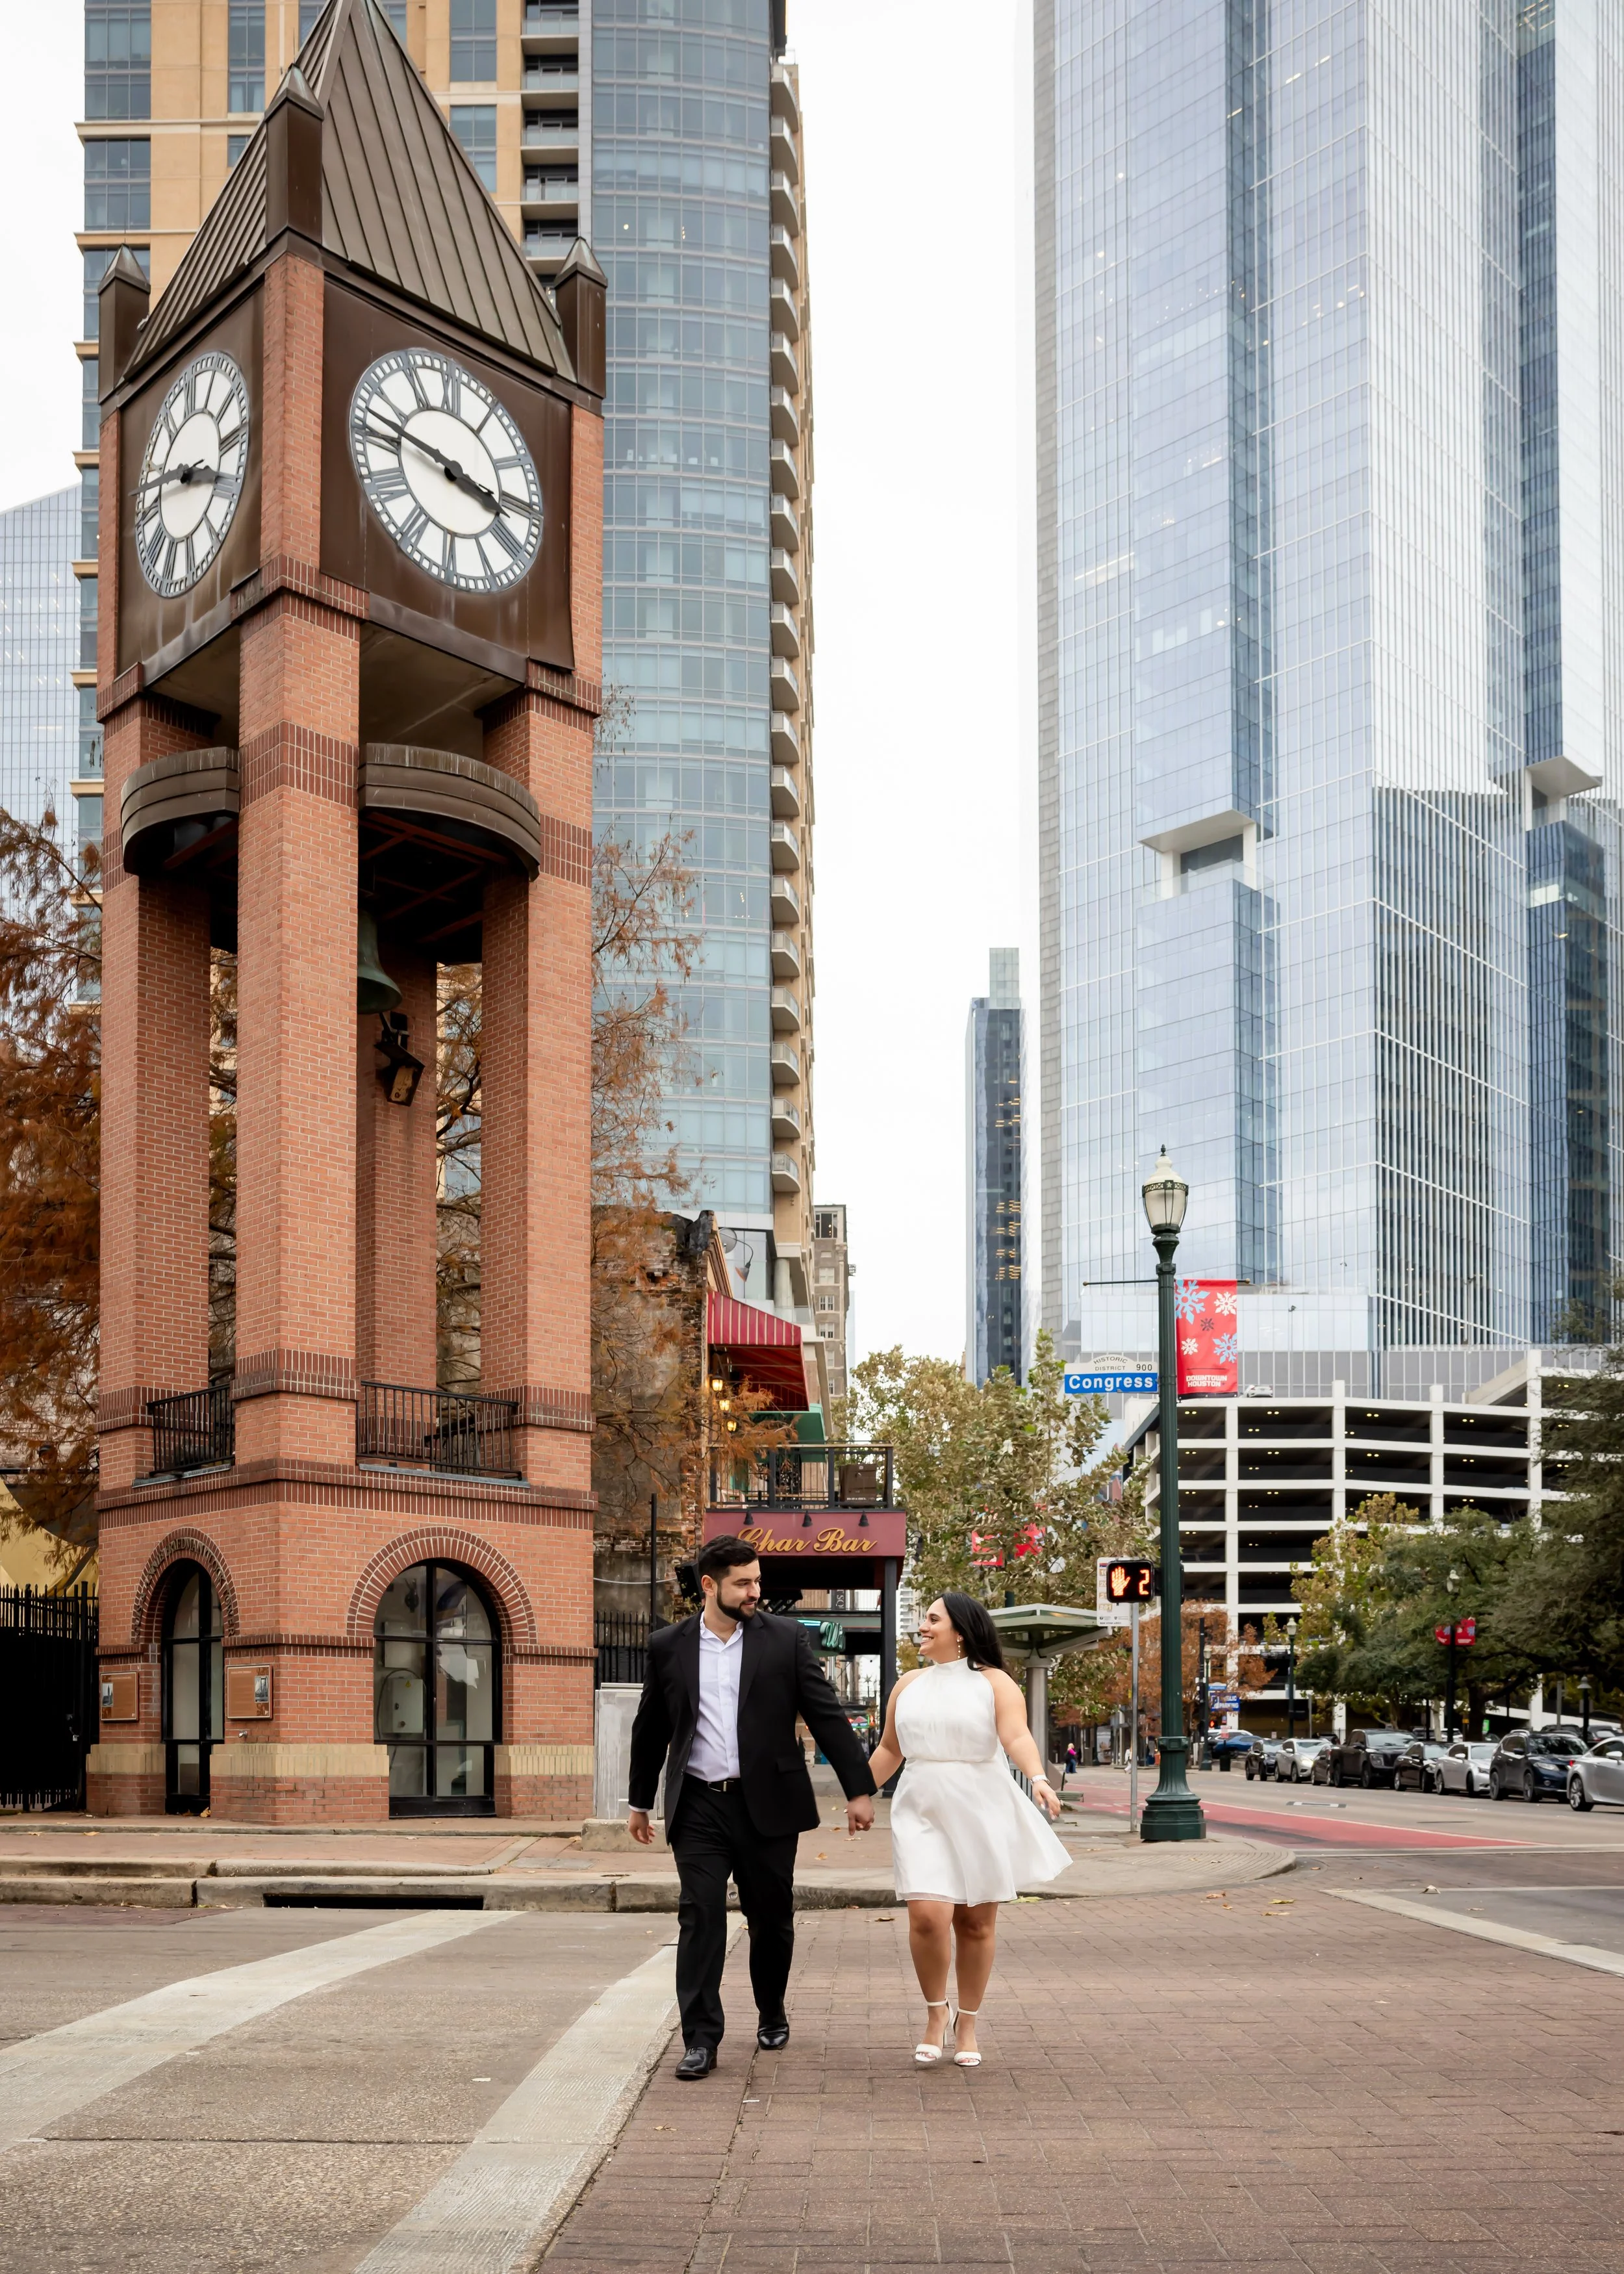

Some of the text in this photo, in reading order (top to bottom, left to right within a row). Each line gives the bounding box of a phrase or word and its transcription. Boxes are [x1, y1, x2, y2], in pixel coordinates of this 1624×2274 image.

[1094, 1356, 1128, 1364] HISTORIC
[1069, 1375, 1153, 1392] Congress
[738, 1527, 878, 1552] Char Bar
[164, 1539, 203, 1558] FRIEDMAN
[223, 1586, 236, 1637] TOWER
[1139, 1570, 1149, 1594] 2
